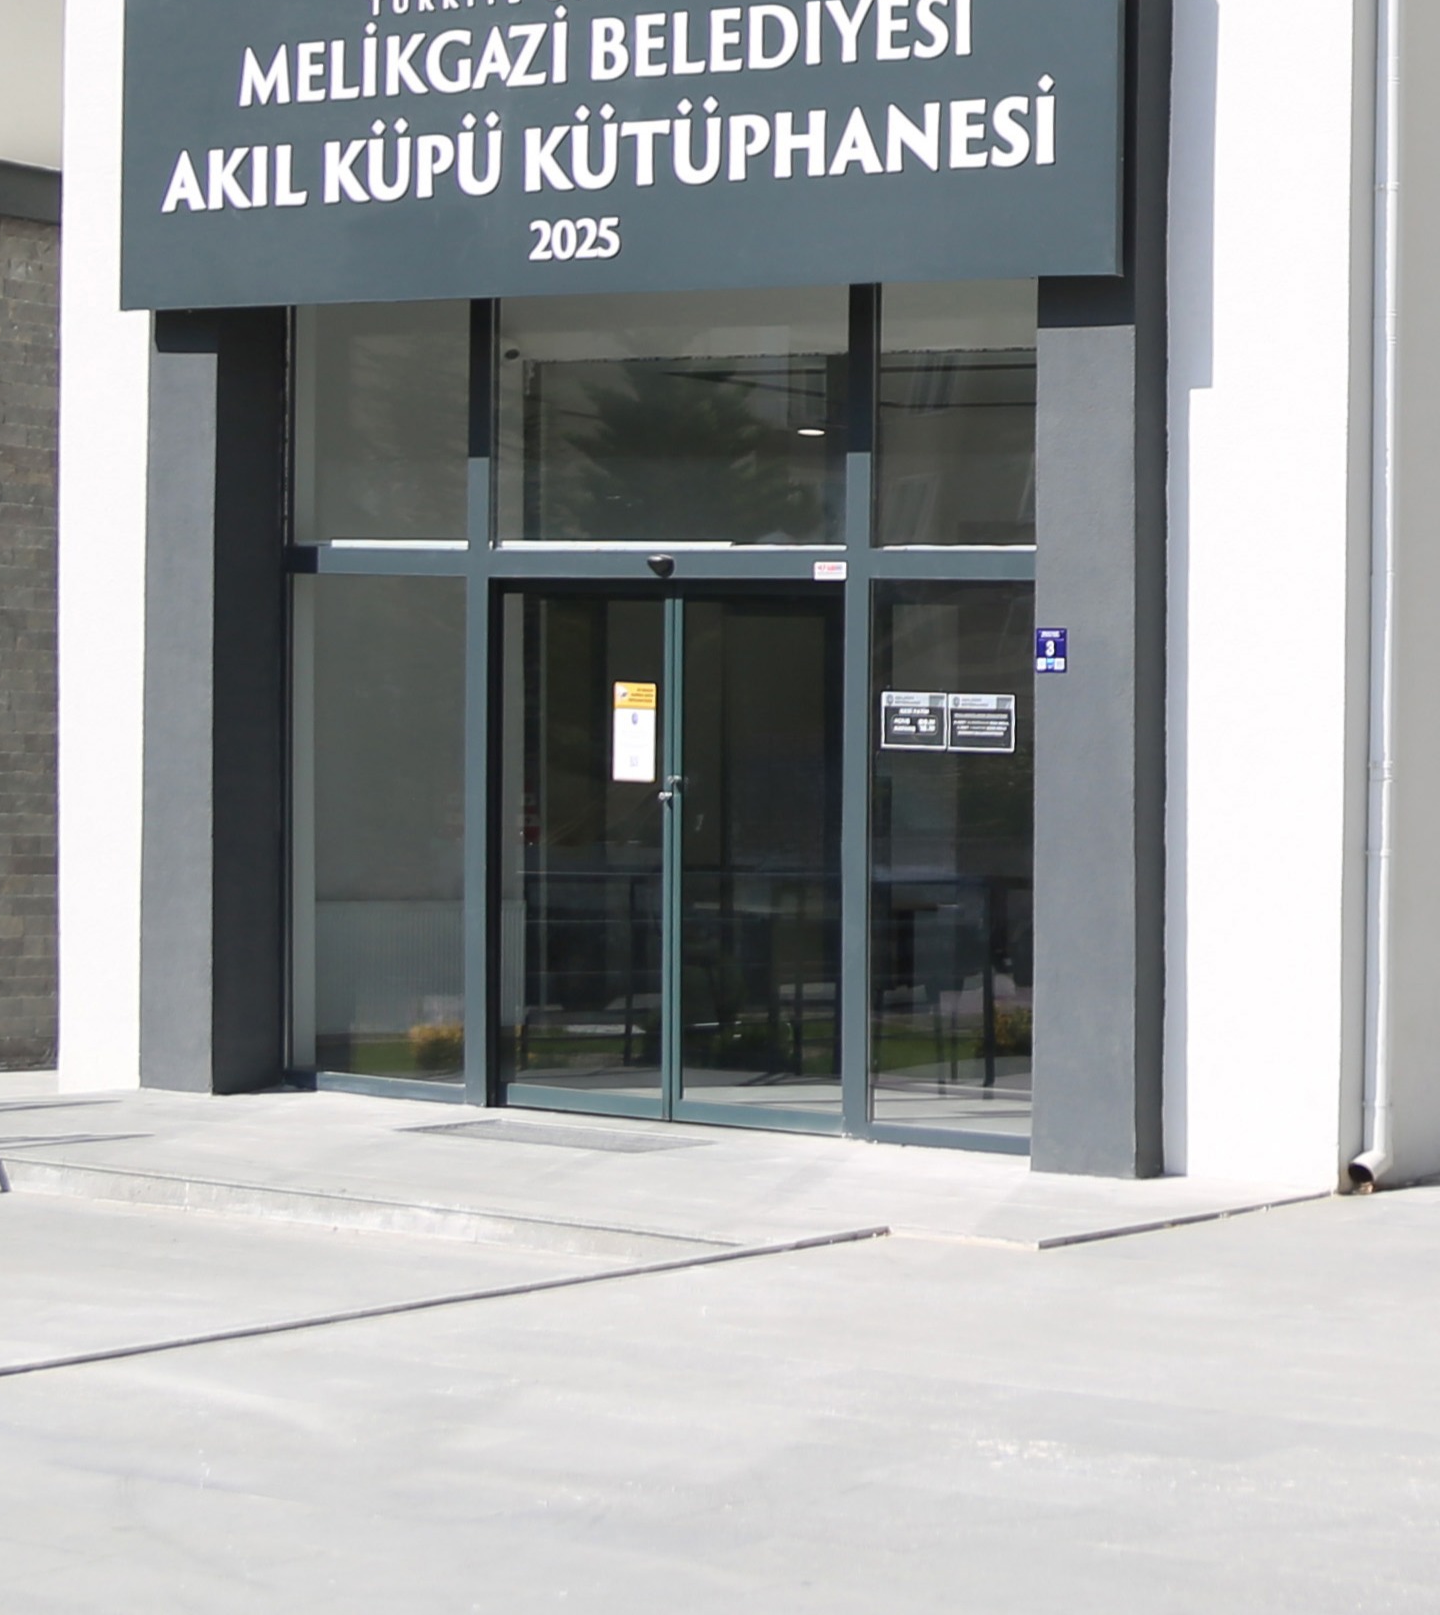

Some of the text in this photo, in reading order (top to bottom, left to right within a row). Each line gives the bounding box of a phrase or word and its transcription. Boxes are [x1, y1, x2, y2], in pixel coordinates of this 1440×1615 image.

[238, 4, 569, 108] MELİKGAZİ
[160, 73, 1056, 214] AKIL KÜPÜ KÜTÜPHANESİ
[528, 216, 621, 262] 2025
